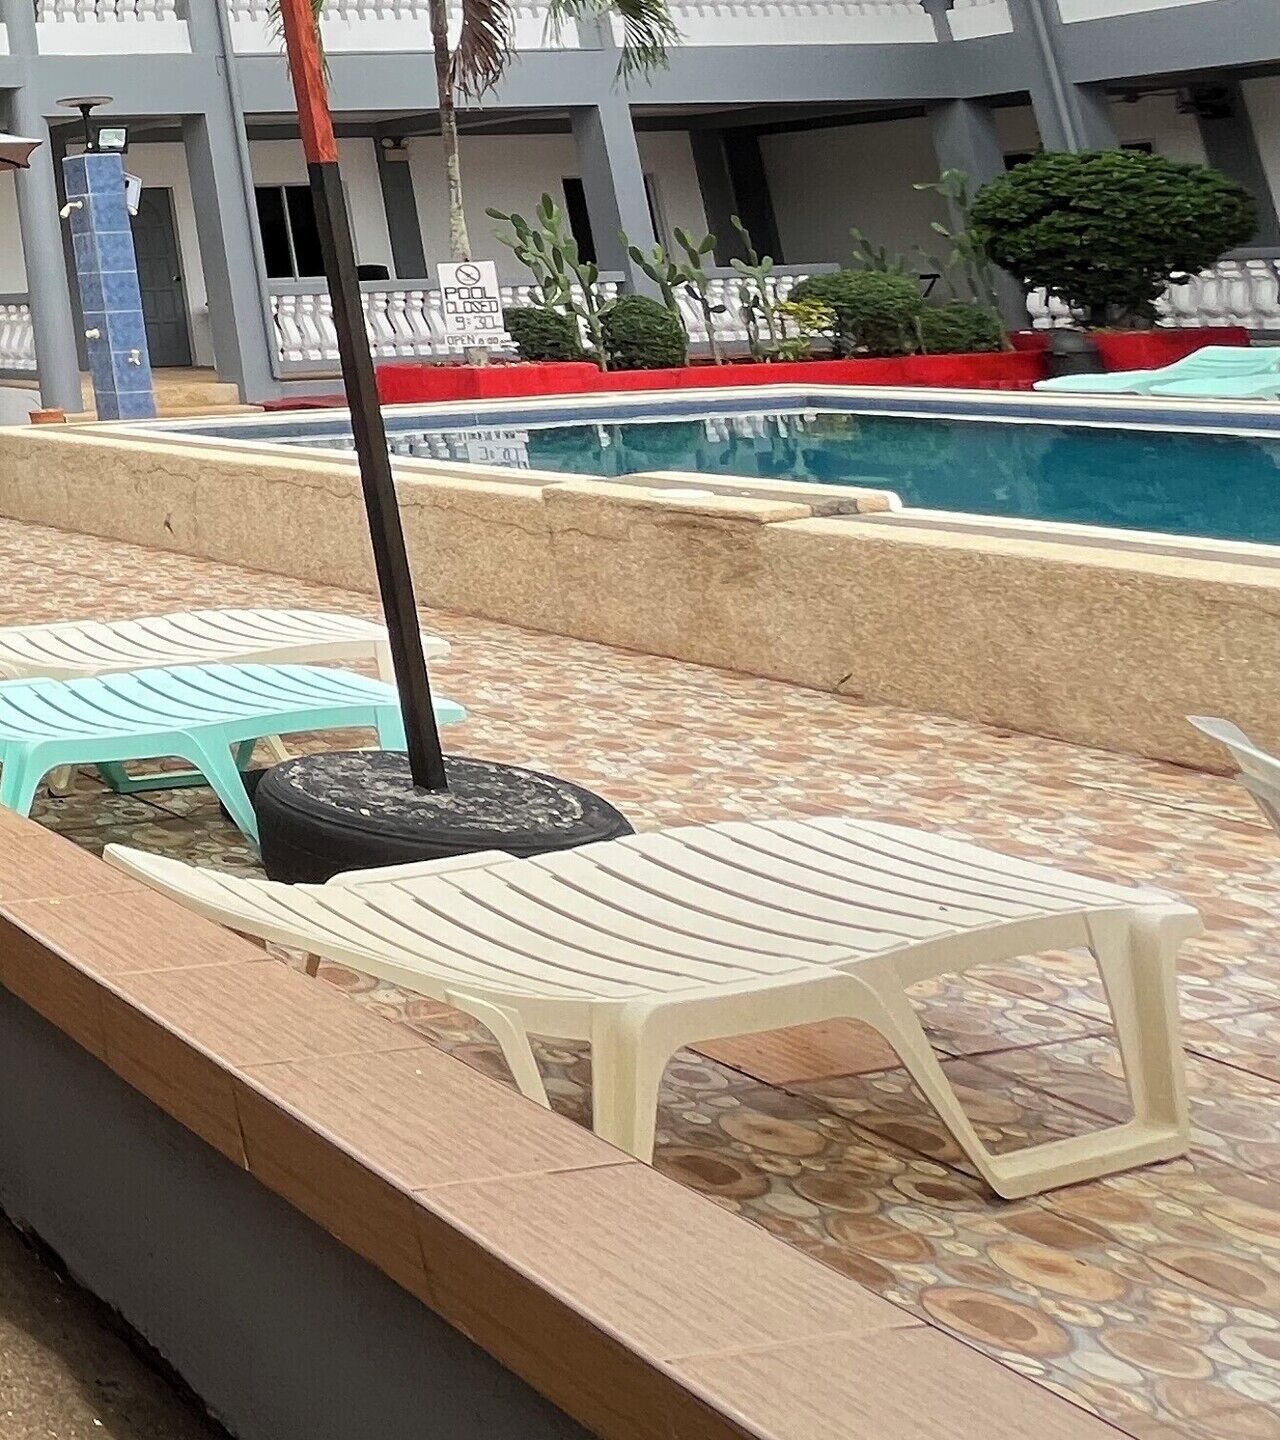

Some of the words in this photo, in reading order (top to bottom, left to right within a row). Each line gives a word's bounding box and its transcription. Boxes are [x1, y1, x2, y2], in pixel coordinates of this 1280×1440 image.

[444, 286, 497, 300] POOL
[446, 301, 499, 314] CLOSED
[446, 334, 475, 346] OPEN
